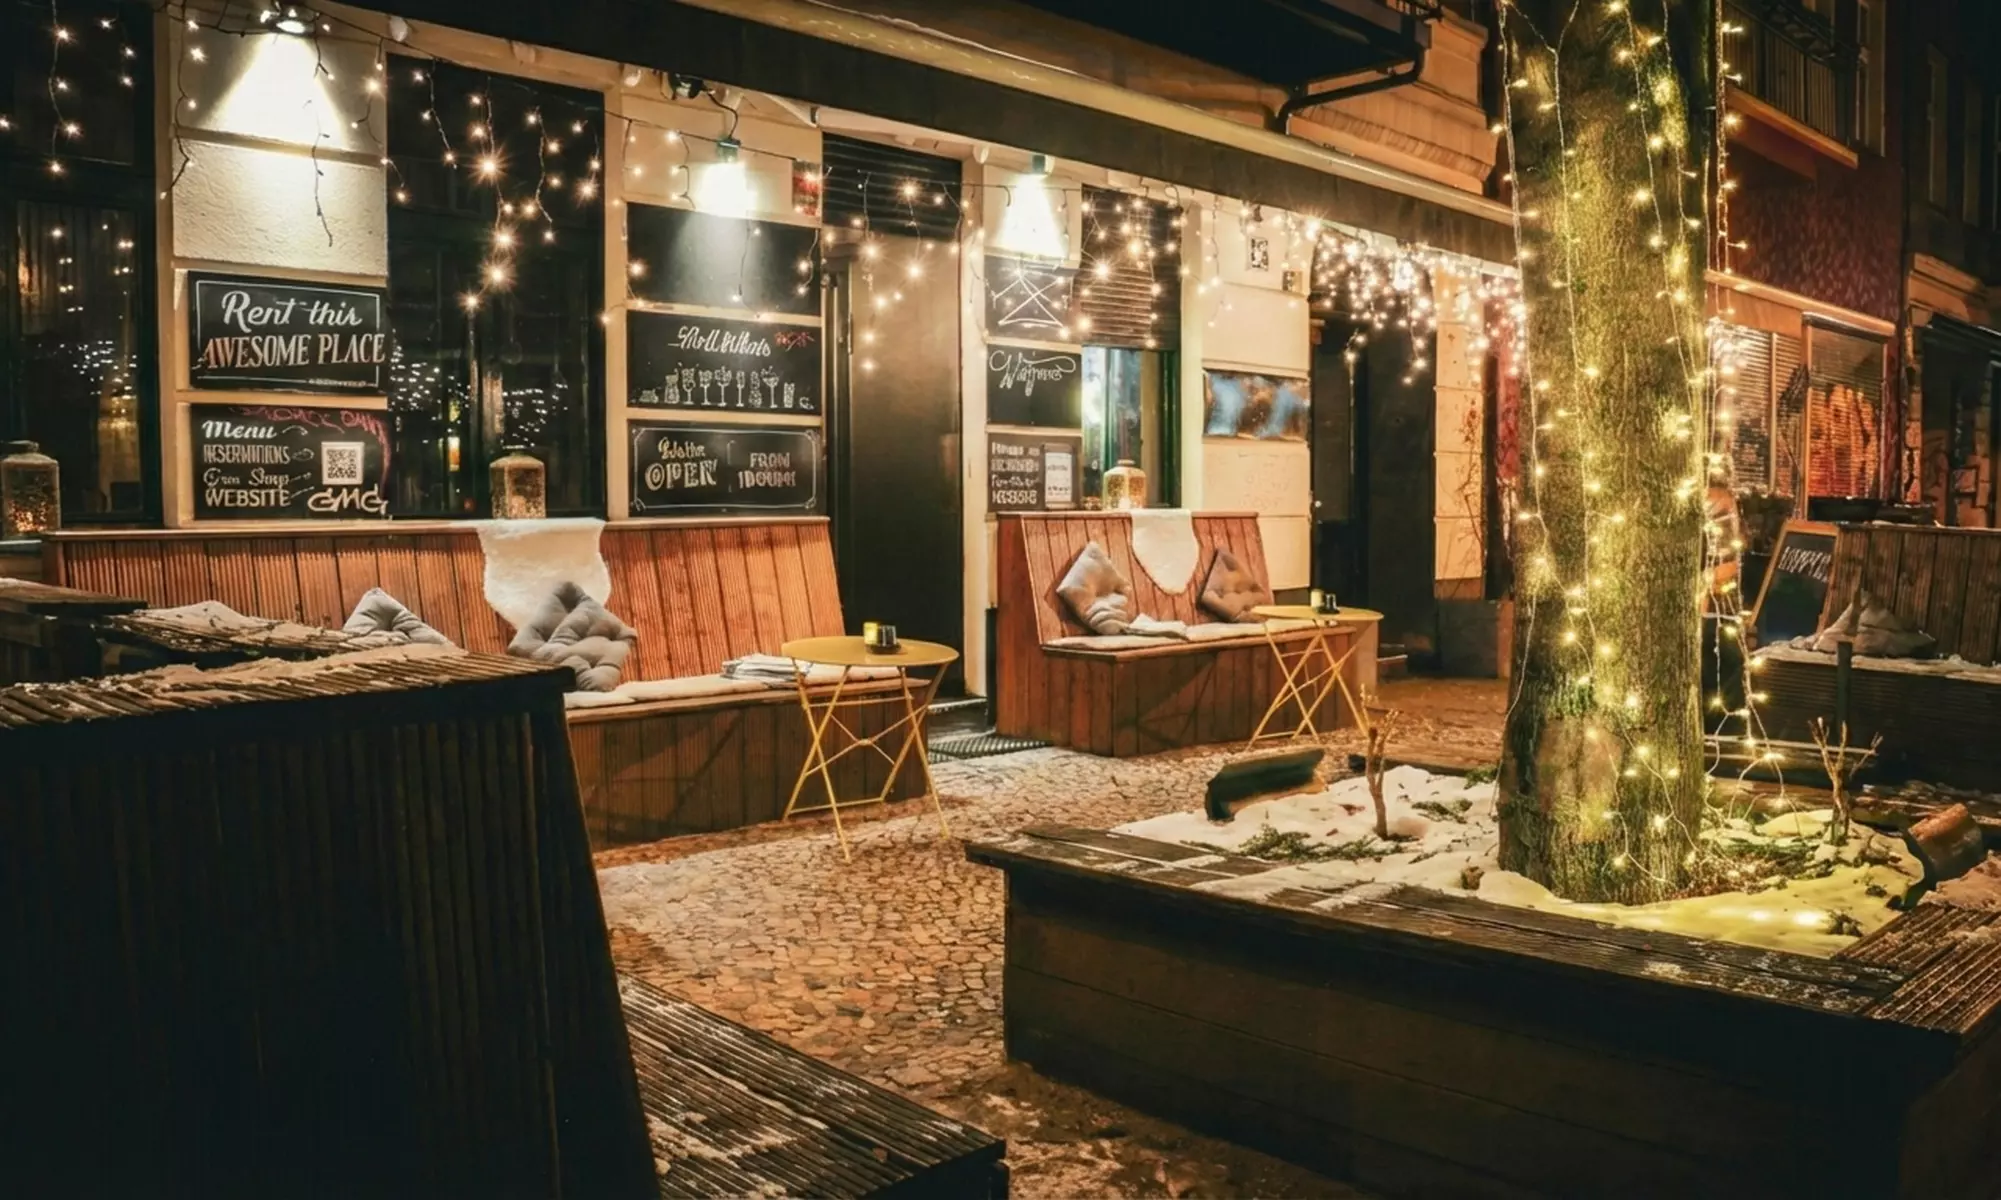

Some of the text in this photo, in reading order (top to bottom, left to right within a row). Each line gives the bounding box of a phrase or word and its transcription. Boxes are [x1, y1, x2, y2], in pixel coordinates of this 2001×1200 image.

[221, 290, 363, 333] Rent this
[202, 333, 386, 369] AWESOME PLACE
[202, 420, 278, 439] Menu
[205, 488, 292, 508] WEBSITE
